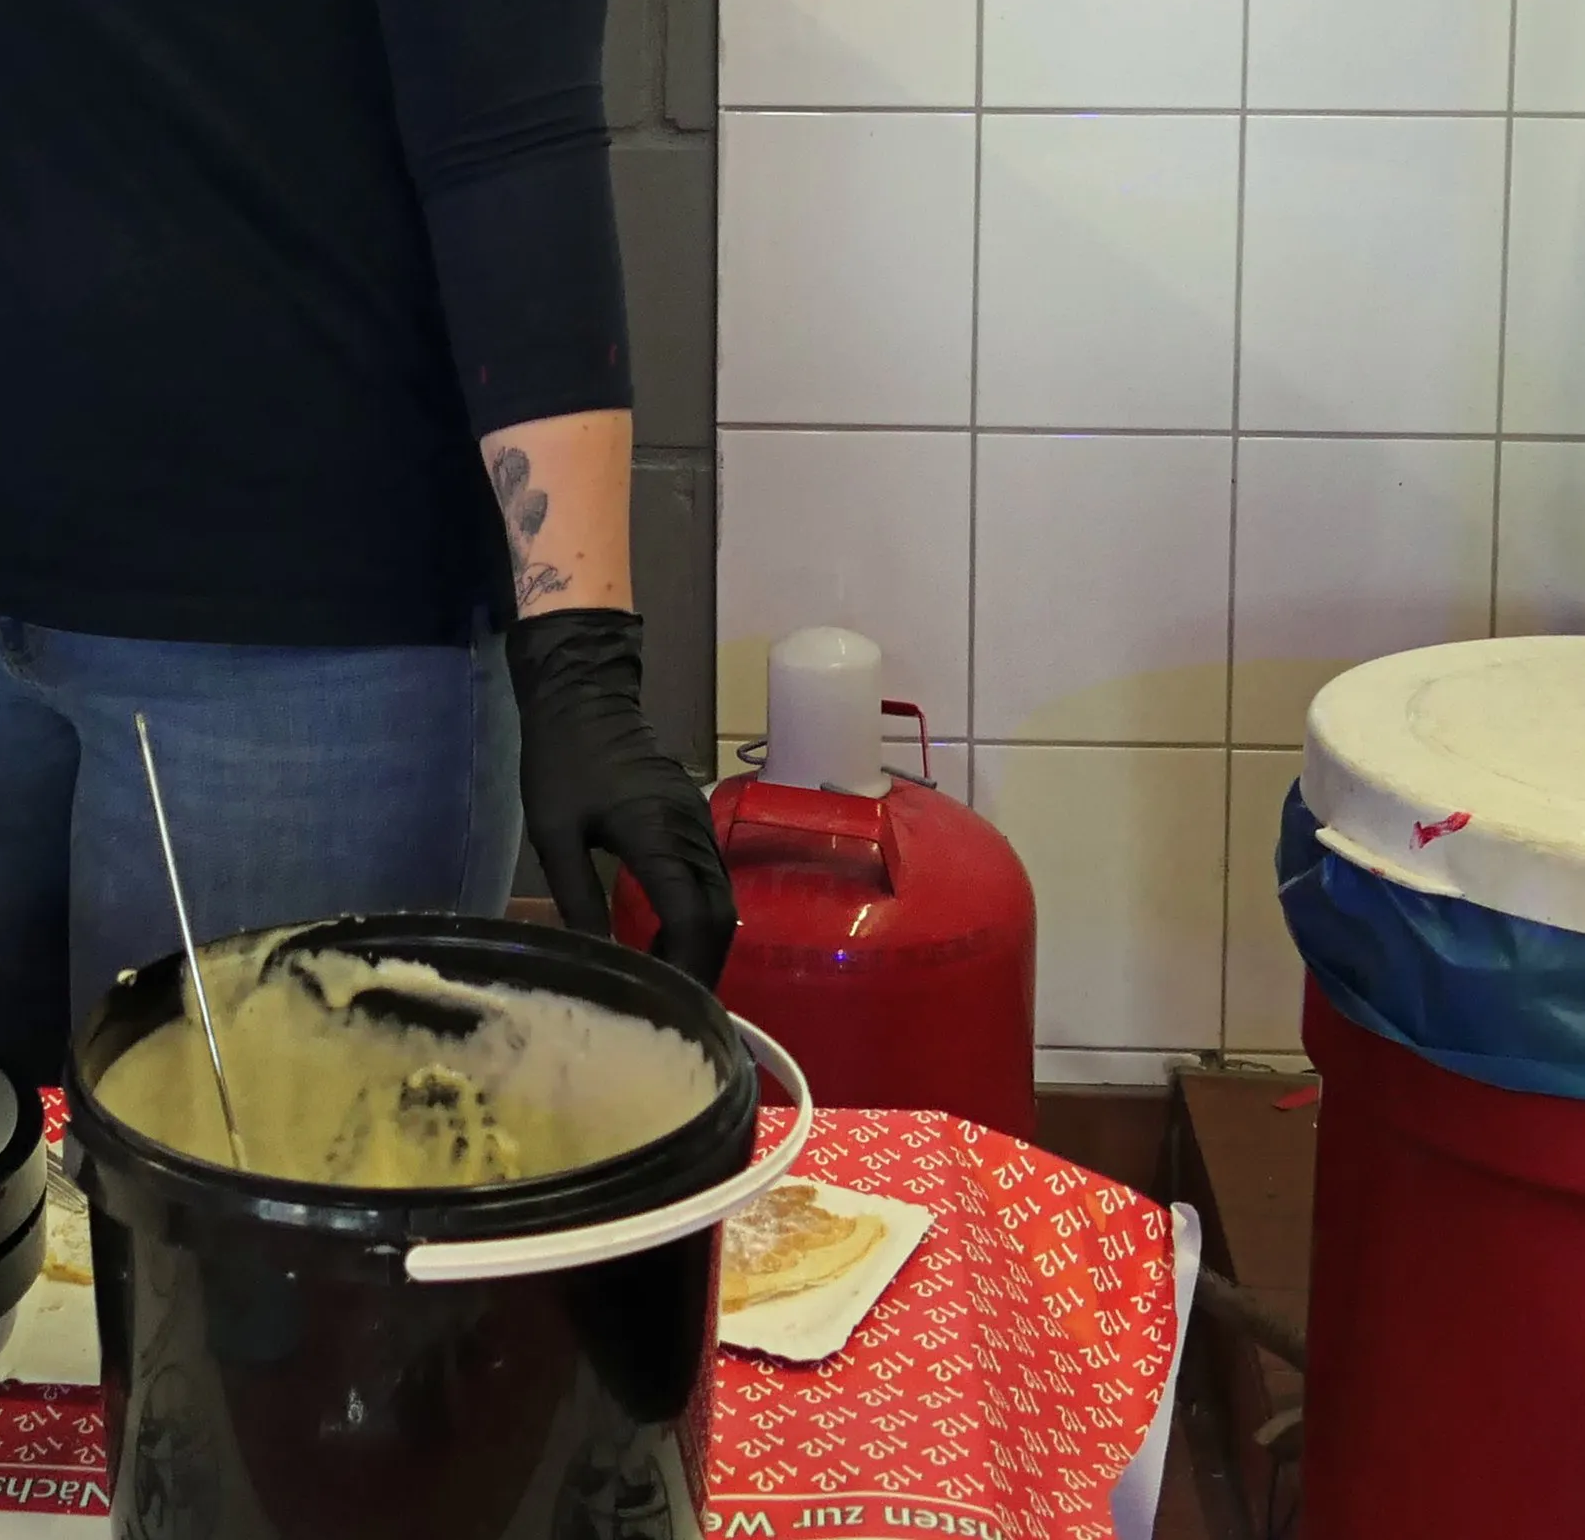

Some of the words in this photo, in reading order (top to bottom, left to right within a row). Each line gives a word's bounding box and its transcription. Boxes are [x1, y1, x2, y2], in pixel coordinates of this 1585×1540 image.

[848, 1122, 889, 1143] 112
[900, 1126, 941, 1148] 112
[807, 1142, 849, 1165] 112
[859, 1148, 901, 1170] 112
[912, 1150, 952, 1170] 112
[849, 1172, 891, 1191] 112
[903, 1172, 945, 1194] 112
[992, 1156, 1036, 1190] 112
[1044, 1166, 1087, 1195] 112
[1096, 1185, 1137, 1214] 112
[997, 1196, 1041, 1230] 112
[1050, 1206, 1090, 1238] 112
[1098, 1230, 1135, 1261] 112
[919, 1248, 962, 1270] 112
[1034, 1243, 1078, 1277] 112
[910, 1273, 953, 1297] 112
[1087, 1265, 1122, 1292] 112
[924, 1301, 968, 1324] 112
[1042, 1287, 1084, 1318] 112
[1094, 1309, 1131, 1336] 112
[855, 1323, 900, 1347] 112
[913, 1326, 958, 1349] 112
[868, 1351, 914, 1381] 112
[1079, 1341, 1120, 1369] 112
[927, 1355, 973, 1382] 112
[737, 1377, 784, 1401] 112
[797, 1381, 844, 1403] 112
[857, 1383, 904, 1406] 112
[918, 1386, 963, 1408] 112
[1092, 1378, 1134, 1404] 112
[13, 1405, 62, 1432] 112
[750, 1404, 797, 1430] 112
[809, 1407, 857, 1429] 112
[870, 1410, 918, 1432] 112
[932, 1413, 979, 1437] 112
[1085, 1406, 1123, 1428] 112
[14, 1437, 62, 1461] 112
[736, 1433, 785, 1458] 112
[798, 1432, 846, 1457] 112
[860, 1435, 908, 1459] 112
[921, 1440, 969, 1465] 112
[1048, 1428, 1080, 1456] 112
[748, 1460, 797, 1492] 112
[811, 1461, 860, 1491] 112
[874, 1465, 922, 1491] 112
[937, 1473, 985, 1498] 112
[1058, 1468, 1097, 1490] 112
[1052, 1491, 1092, 1513] 112
[792, 1505, 864, 1528] zur
